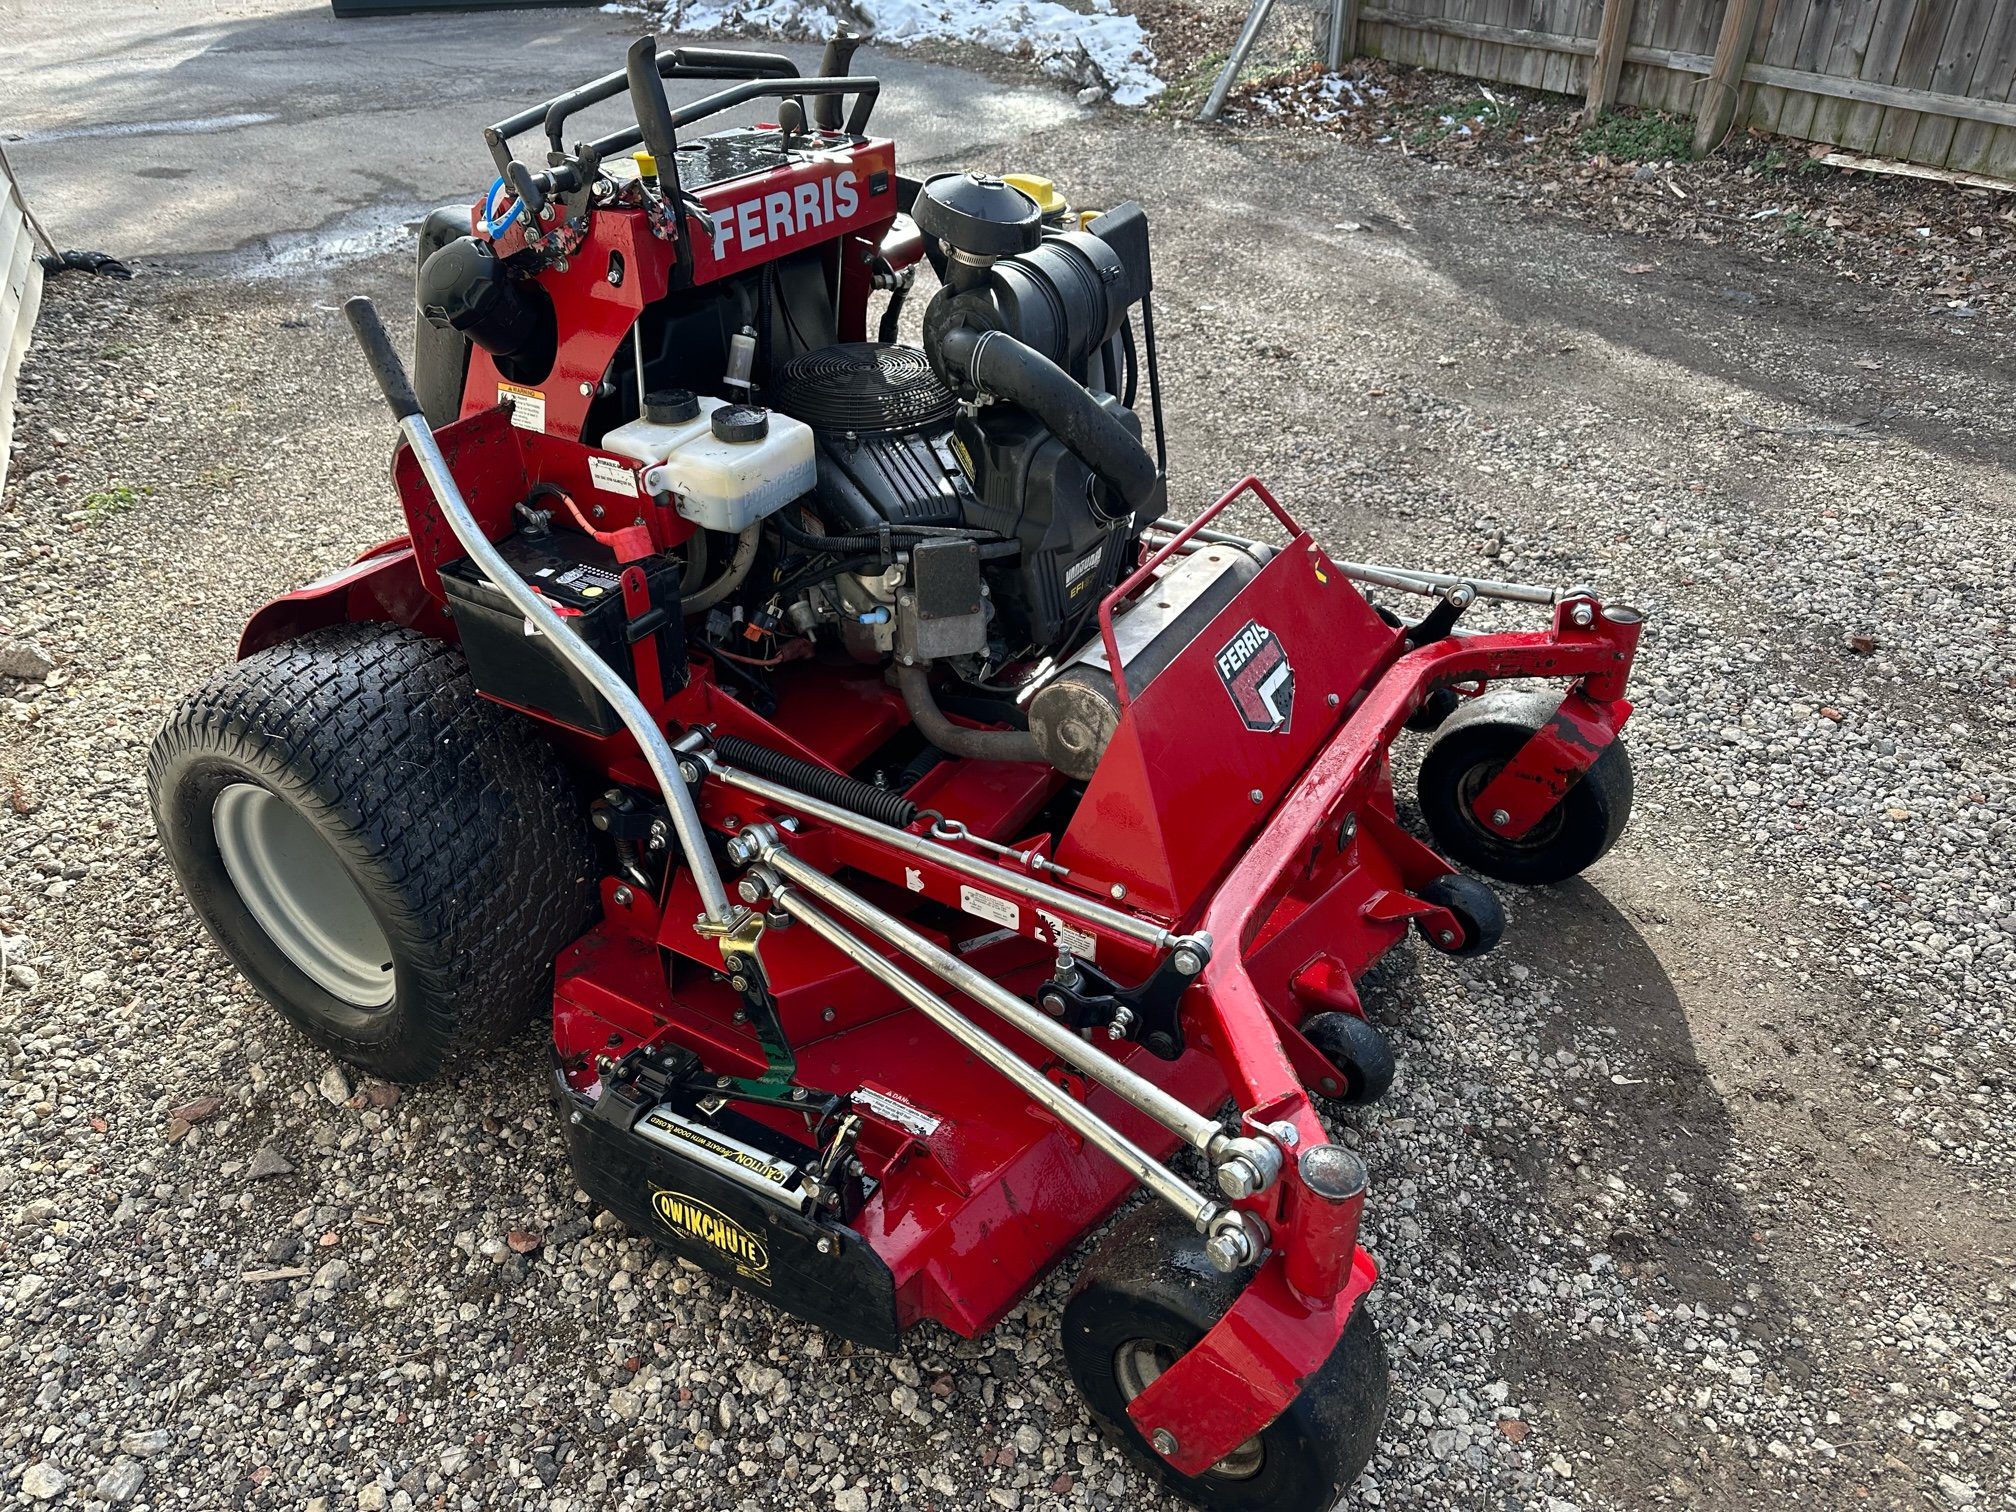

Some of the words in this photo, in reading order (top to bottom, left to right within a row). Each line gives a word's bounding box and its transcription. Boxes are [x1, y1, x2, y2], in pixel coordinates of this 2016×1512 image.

[711, 171, 859, 261] FERRIS
[1070, 581, 1084, 599] EFI
[1218, 624, 1270, 680] FERRIS
[673, 1126, 692, 1138] DOOR
[690, 1133, 707, 1144] WITH
[705, 1140, 733, 1158] OPERATE
[735, 1154, 785, 1181] CAUTION
[661, 1195, 757, 1261] QWIKCHUTE
